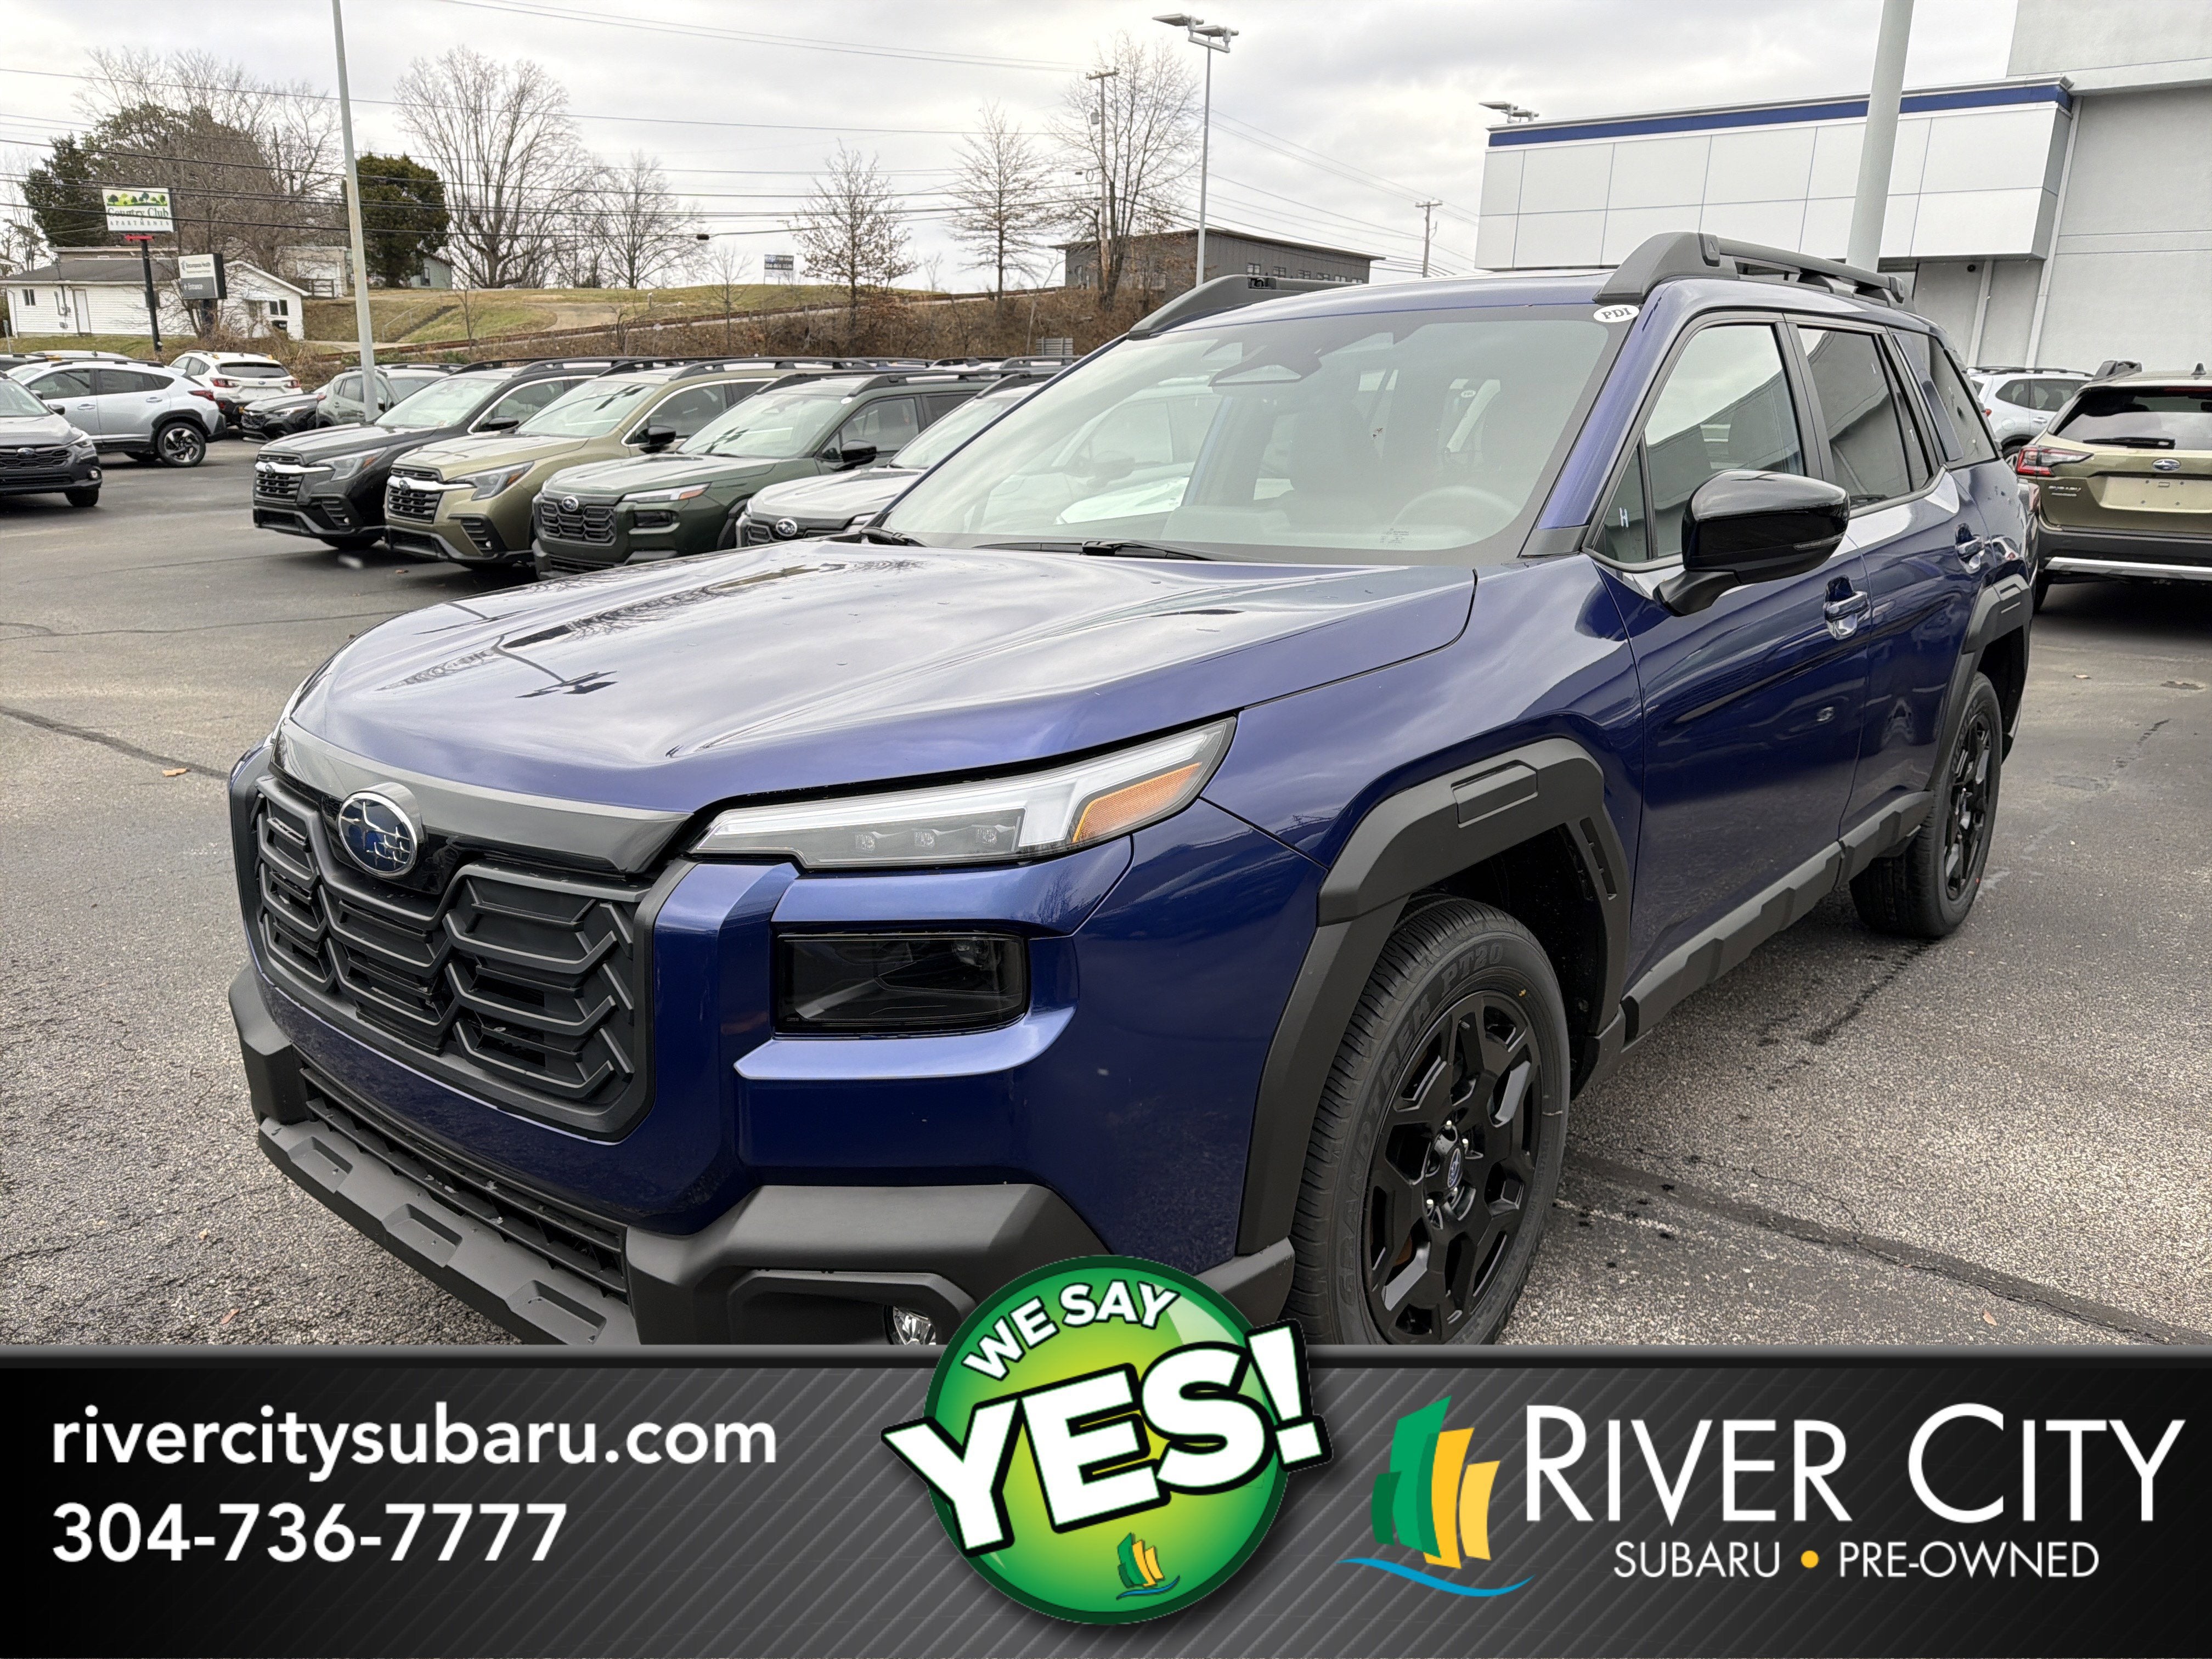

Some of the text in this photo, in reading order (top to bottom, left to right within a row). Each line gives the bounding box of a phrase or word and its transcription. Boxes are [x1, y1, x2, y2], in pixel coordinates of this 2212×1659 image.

[108, 207, 169, 220] Country Club
[1601, 308, 1632, 319] PDI
